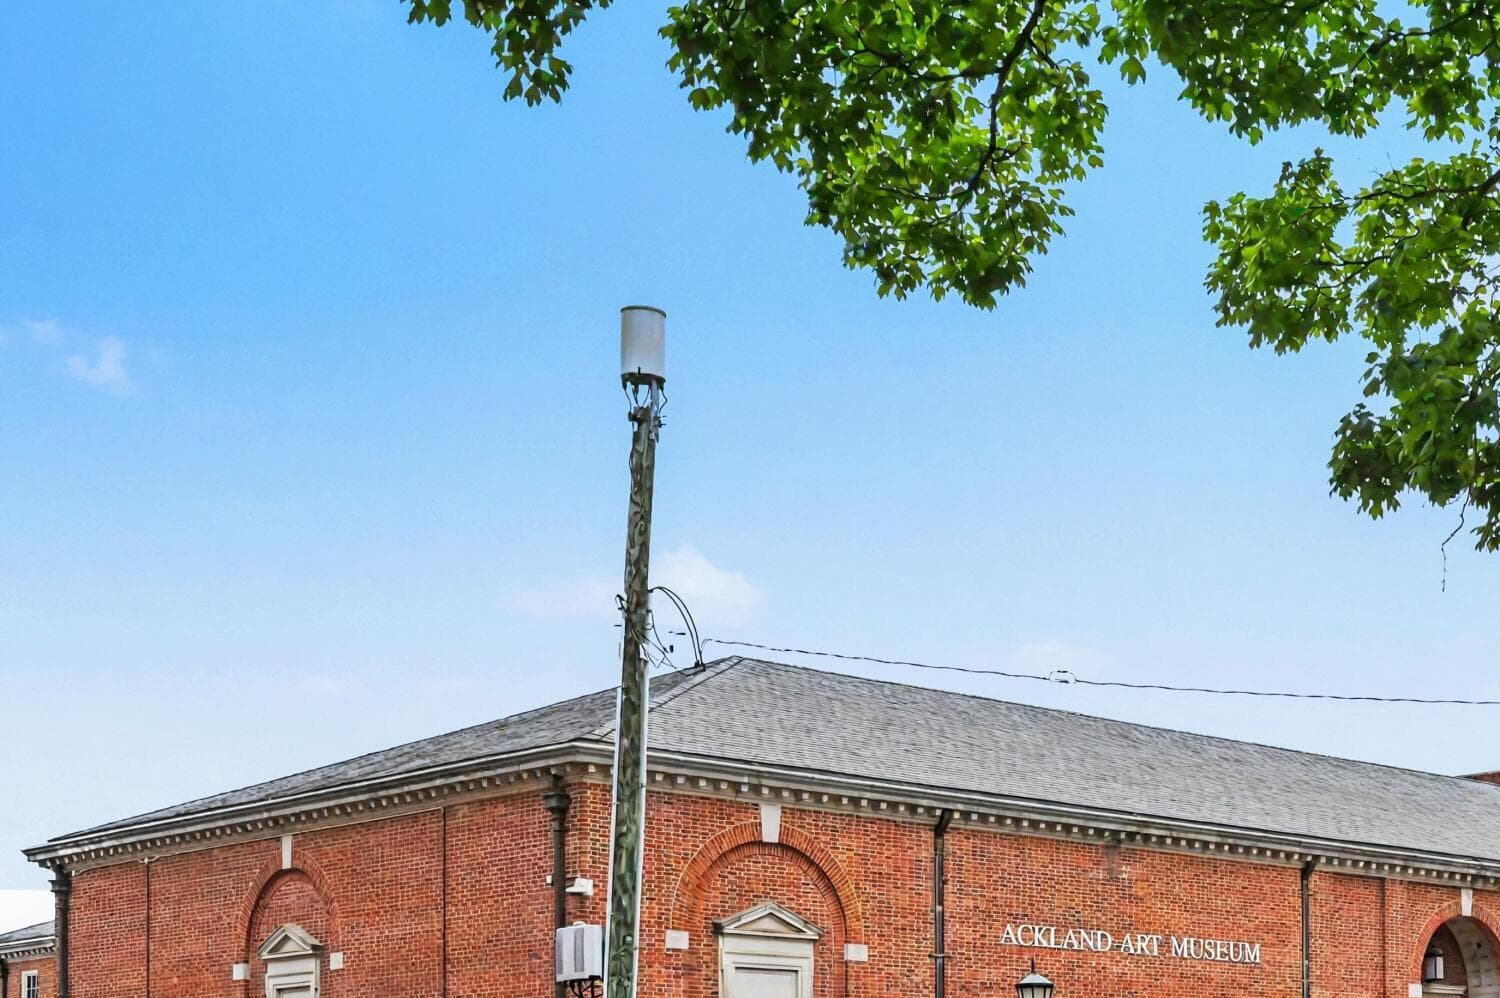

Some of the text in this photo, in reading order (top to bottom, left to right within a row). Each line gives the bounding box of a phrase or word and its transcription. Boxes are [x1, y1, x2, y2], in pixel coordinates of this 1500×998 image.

[1000, 923, 1262, 964] ACKLAND ART MUSEUM
